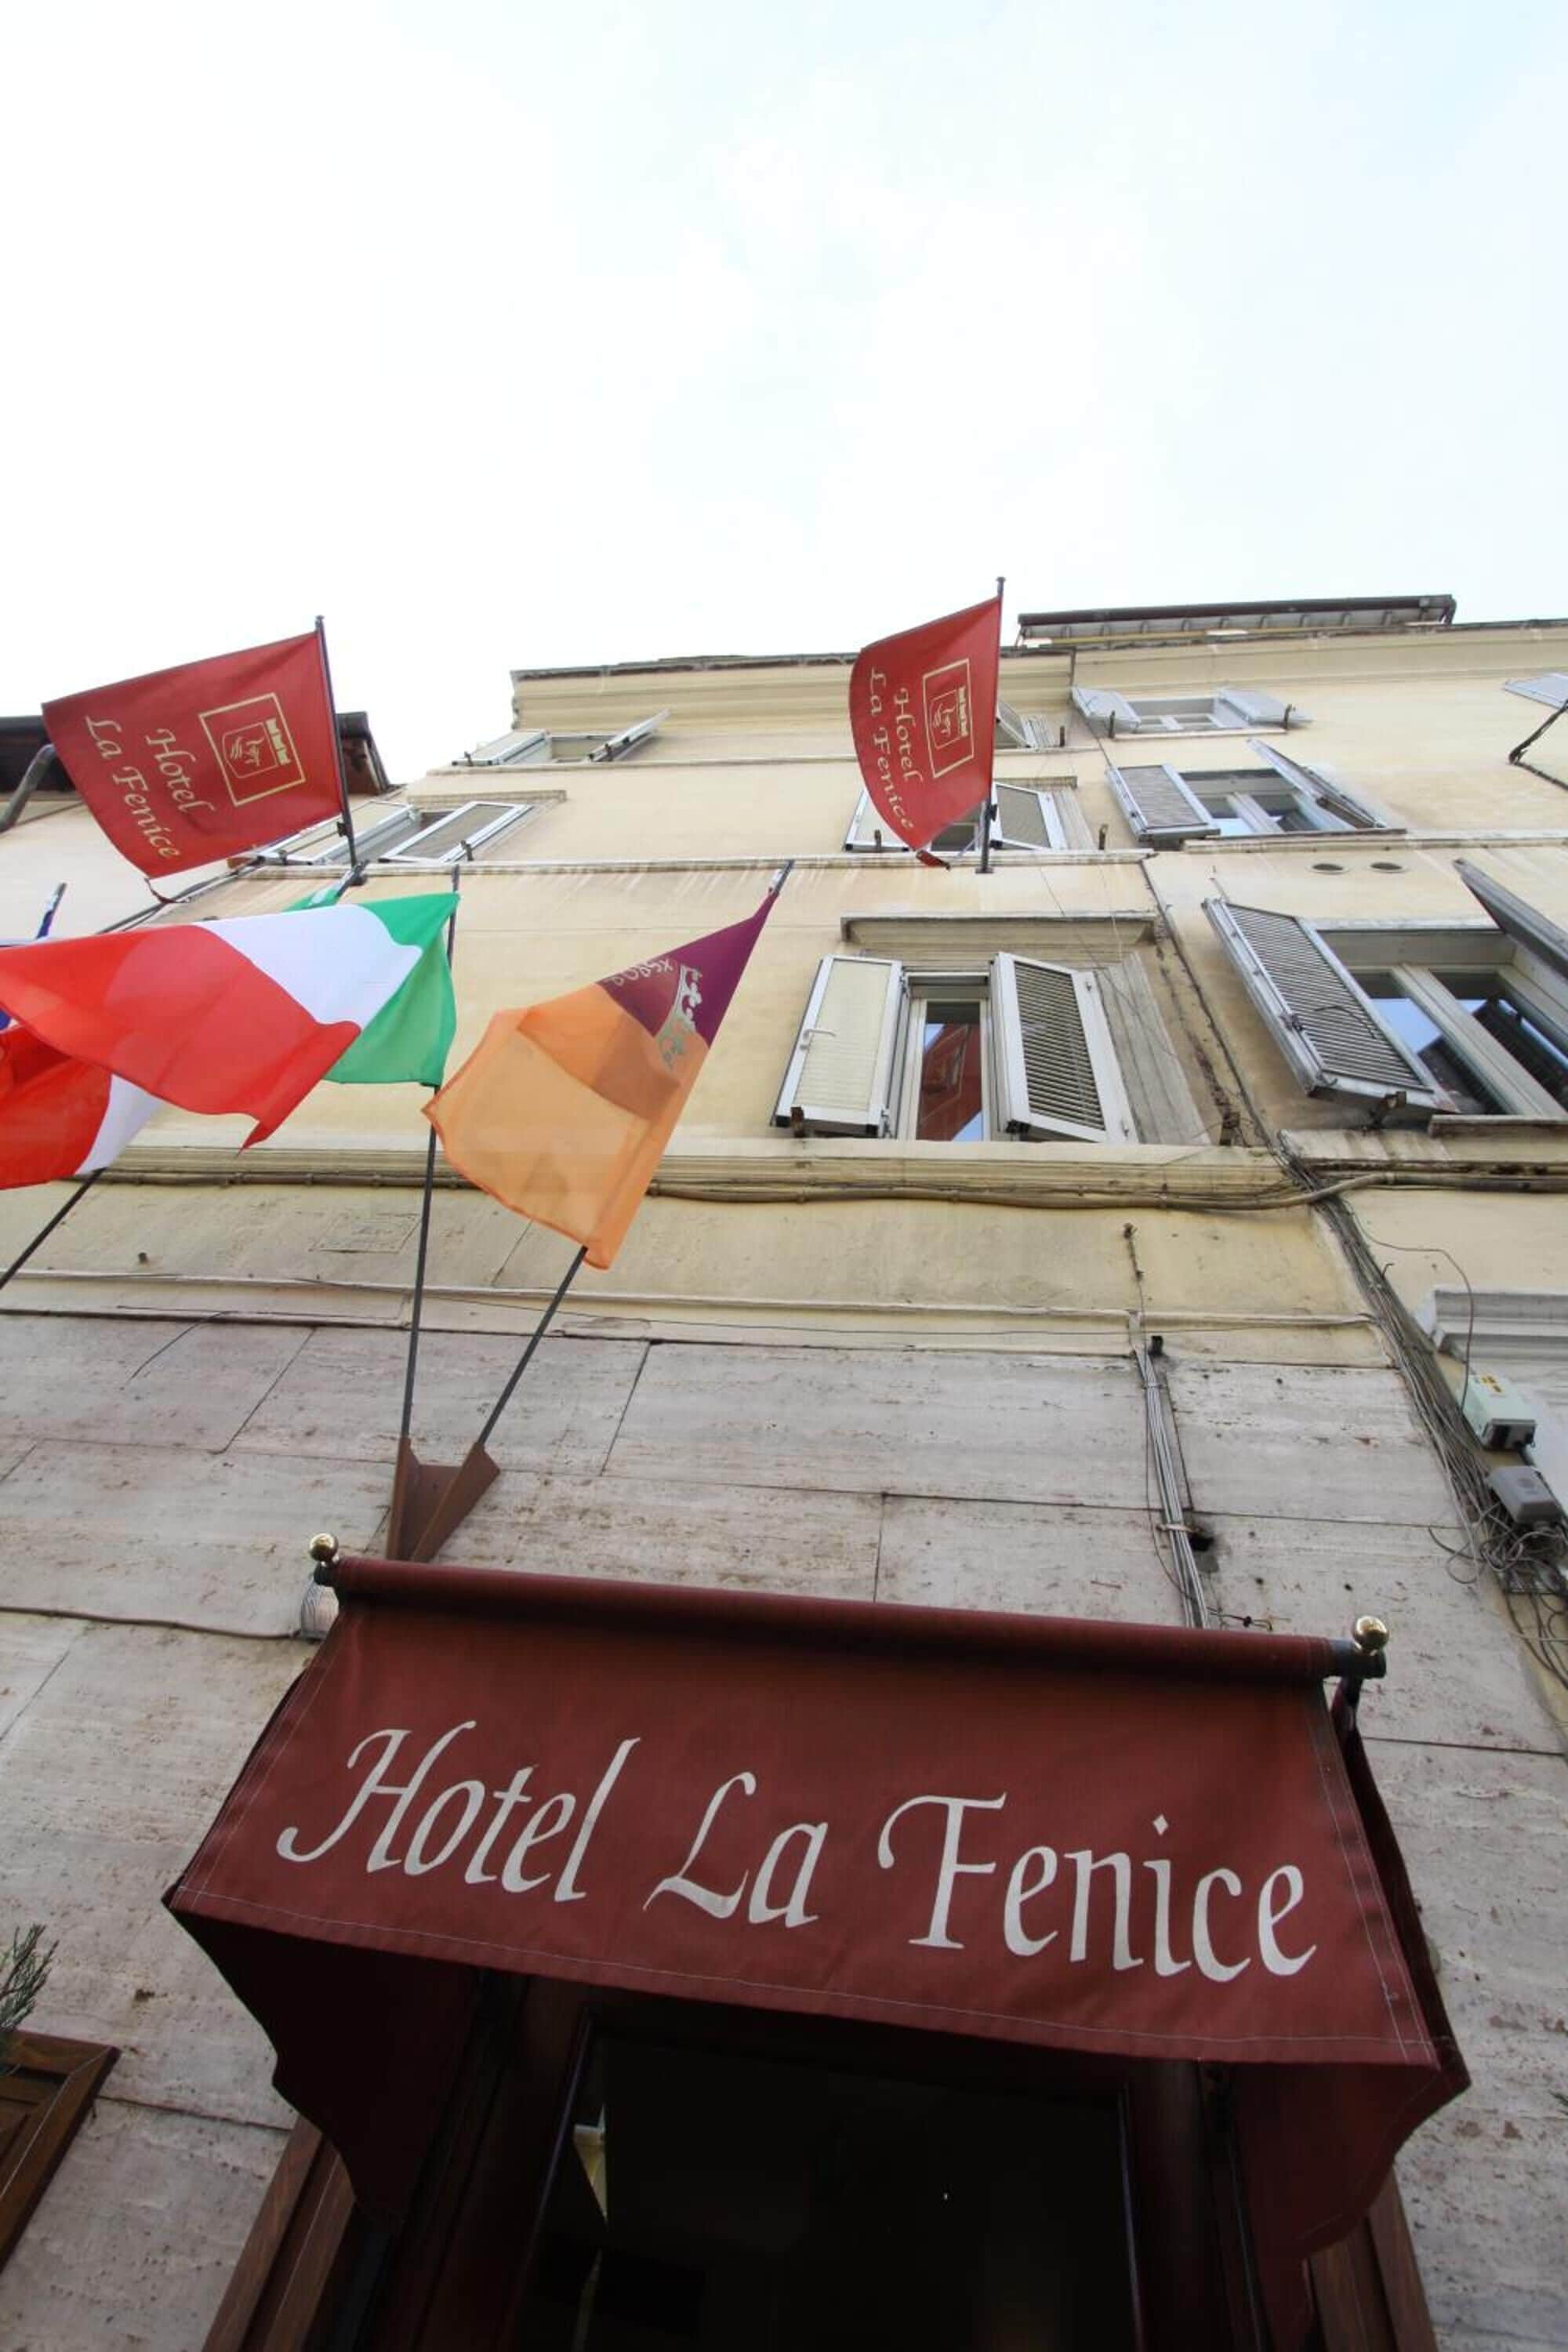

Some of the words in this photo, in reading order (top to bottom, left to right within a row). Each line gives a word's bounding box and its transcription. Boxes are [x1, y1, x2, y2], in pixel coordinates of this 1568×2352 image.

[869, 666, 887, 716] La
[893, 687, 924, 785] Hotel
[85, 714, 122, 760] La
[111, 764, 182, 860] Fenice
[145, 727, 215, 814] Hotel
[873, 726, 915, 829] Fenice
[276, 1720, 641, 1903] Hotel
[643, 1771, 828, 1929] La
[877, 1791, 1317, 1982] Fenice
